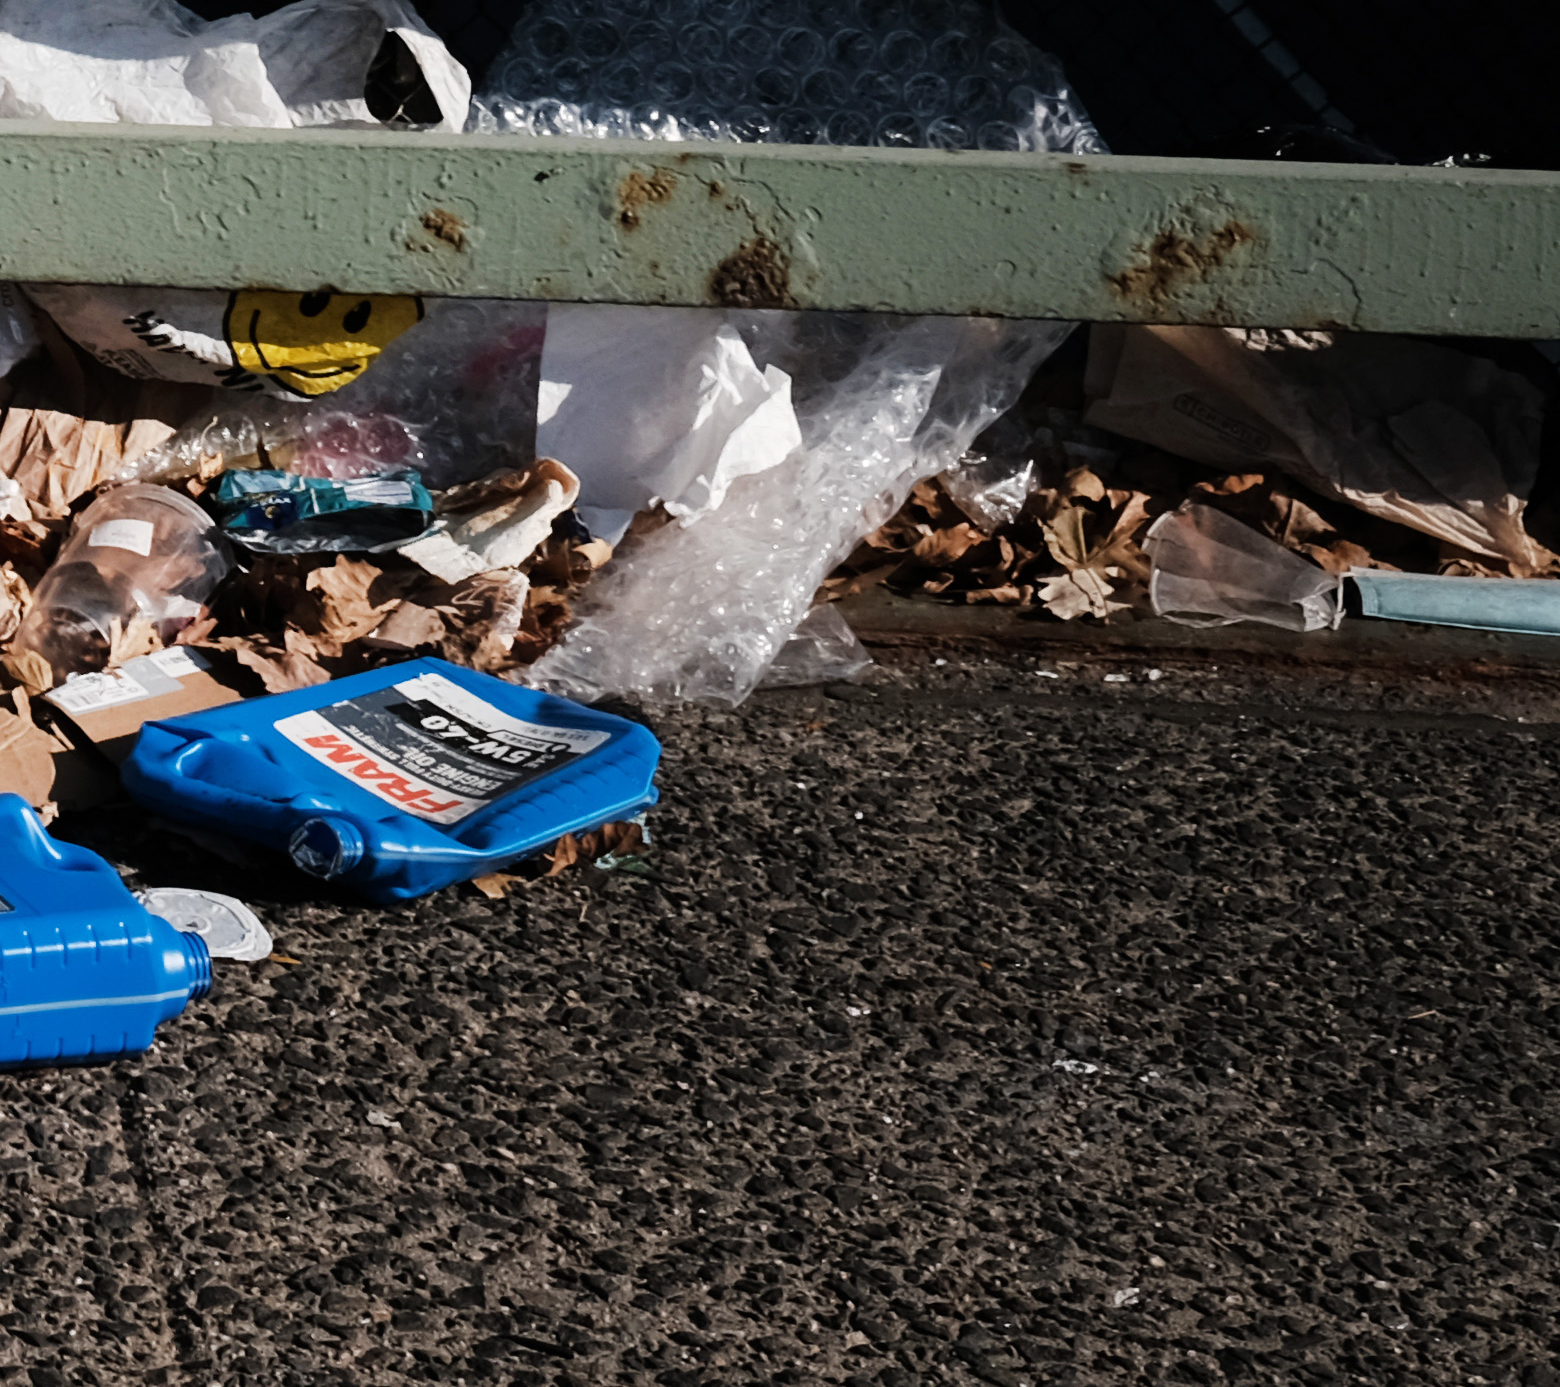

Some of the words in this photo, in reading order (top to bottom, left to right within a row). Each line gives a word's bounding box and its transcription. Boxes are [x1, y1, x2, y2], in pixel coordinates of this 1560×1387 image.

[400, 744, 439, 767] OIL
[420, 715, 533, 765] 5W-40
[300, 732, 464, 815] FRAM
[429, 760, 504, 793] ENGINE
